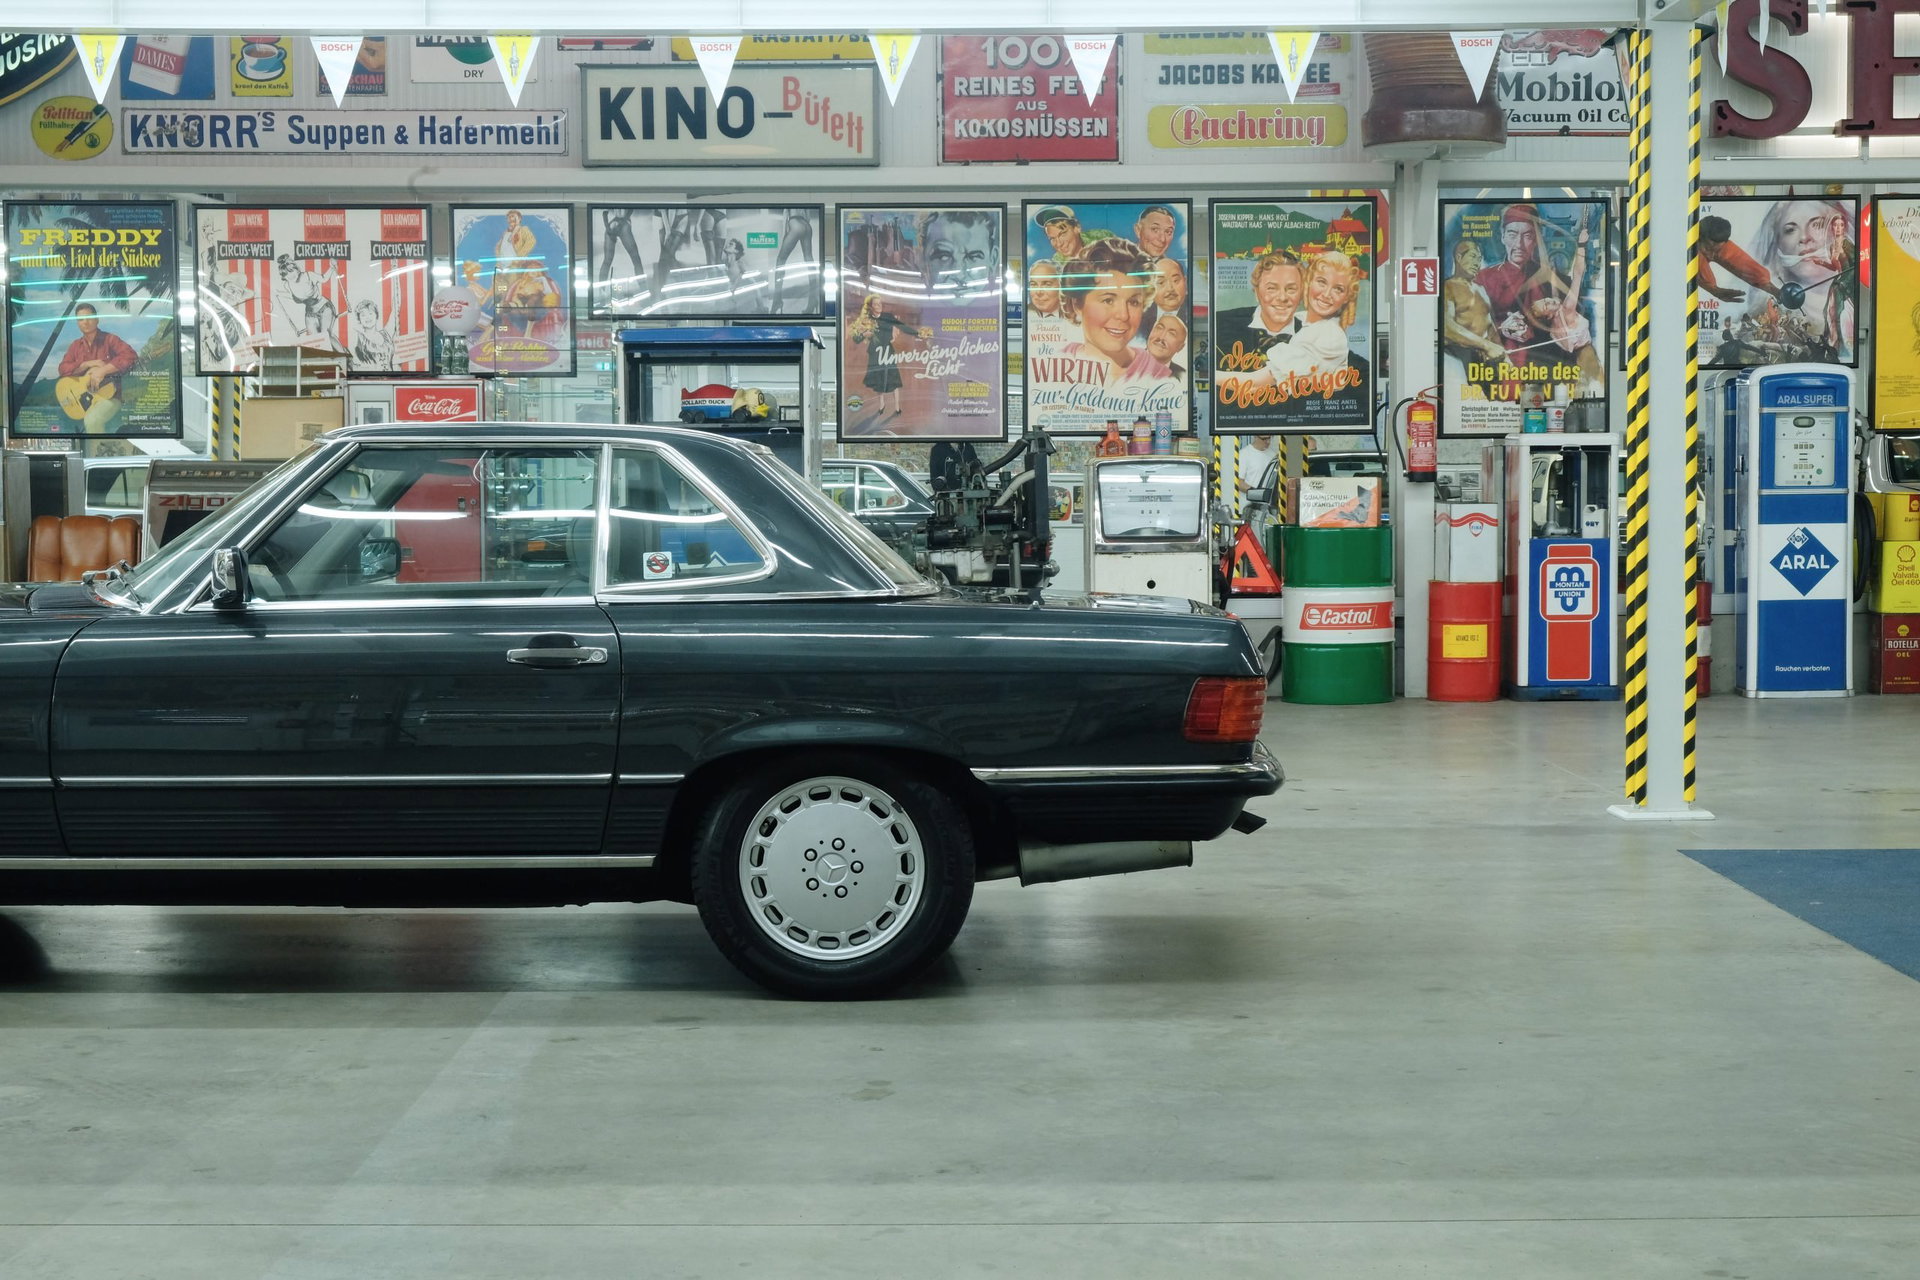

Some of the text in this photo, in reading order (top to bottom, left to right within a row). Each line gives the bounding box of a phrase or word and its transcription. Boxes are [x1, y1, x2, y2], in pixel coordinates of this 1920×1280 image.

[320, 44, 353, 52] BOSCH
[700, 44, 732, 52] BOSCH
[1074, 42, 1106, 50] BOSCH
[1460, 39, 1493, 47] BOSCH
[980, 36, 1073, 67] 100
[137, 47, 176, 72] DAMES
[463, 70, 484, 78] DRY
[1159, 63, 1330, 85] JACOBS KAEE
[955, 76, 1107, 97] REINES FET
[42, 106, 93, 120] Pelikan
[1015, 100, 1047, 111] AUS
[1503, 108, 1571, 123] Vacuum
[1577, 108, 1601, 123] Oil
[288, 115, 559, 150] Suppen & Hafermehl
[954, 113, 1109, 138] KOKOSNÜSSEN
[1258, 213, 1275, 221] HANS
[1276, 213, 1289, 221] HOLT
[1267, 221, 1282, 229] WOLF
[19, 229, 162, 246] FREDDY
[71, 247, 96, 268] Lied
[99, 247, 119, 268] der
[121, 247, 162, 268] Südsee
[1031, 333, 1062, 342] WESSELY
[875, 335, 999, 366] Unvergängliches
[914, 360, 965, 379] Licht
[1031, 357, 1110, 387] WIRTIN
[1468, 361, 1580, 382] Die Rache des
[1219, 366, 1363, 409] Obersteiger
[1490, 383, 1509, 400] FU
[407, 398, 463, 416] Coca-Cola
[1777, 394, 1833, 405] ARAL SUPER
[1779, 554, 1830, 570] ARAL
[1897, 564, 1915, 572] Shell
[1891, 578, 1904, 586] Oel
[1893, 571, 1919, 579] Valvata
[1558, 590, 1582, 598] UNION
[1321, 608, 1372, 625] Castrol
[1888, 639, 1919, 649] ROTELLA
